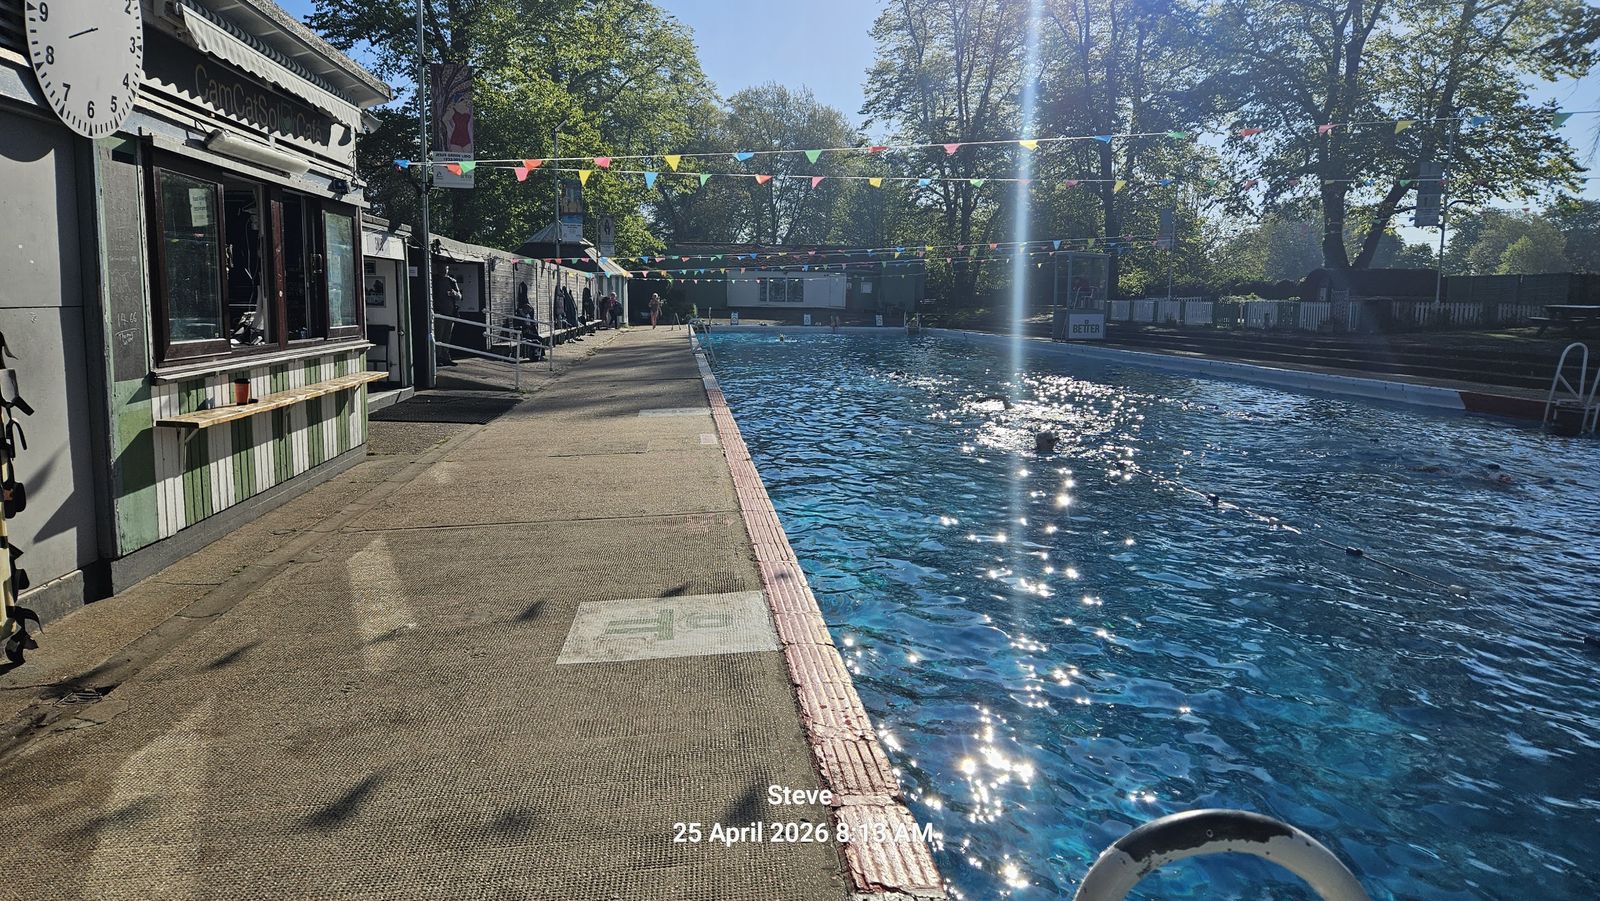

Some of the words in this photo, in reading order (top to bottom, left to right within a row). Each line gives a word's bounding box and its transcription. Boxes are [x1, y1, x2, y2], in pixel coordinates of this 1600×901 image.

[39, 2, 49, 22] 9
[124, 0, 132, 15] 2
[129, 36, 136, 54] 3
[45, 45, 54, 65] 8
[122, 73, 130, 90] 4
[62, 82, 71, 102] 7
[87, 100, 95, 119] 6
[110, 95, 118, 113] 5
[1072, 324, 1100, 334] BETTER
